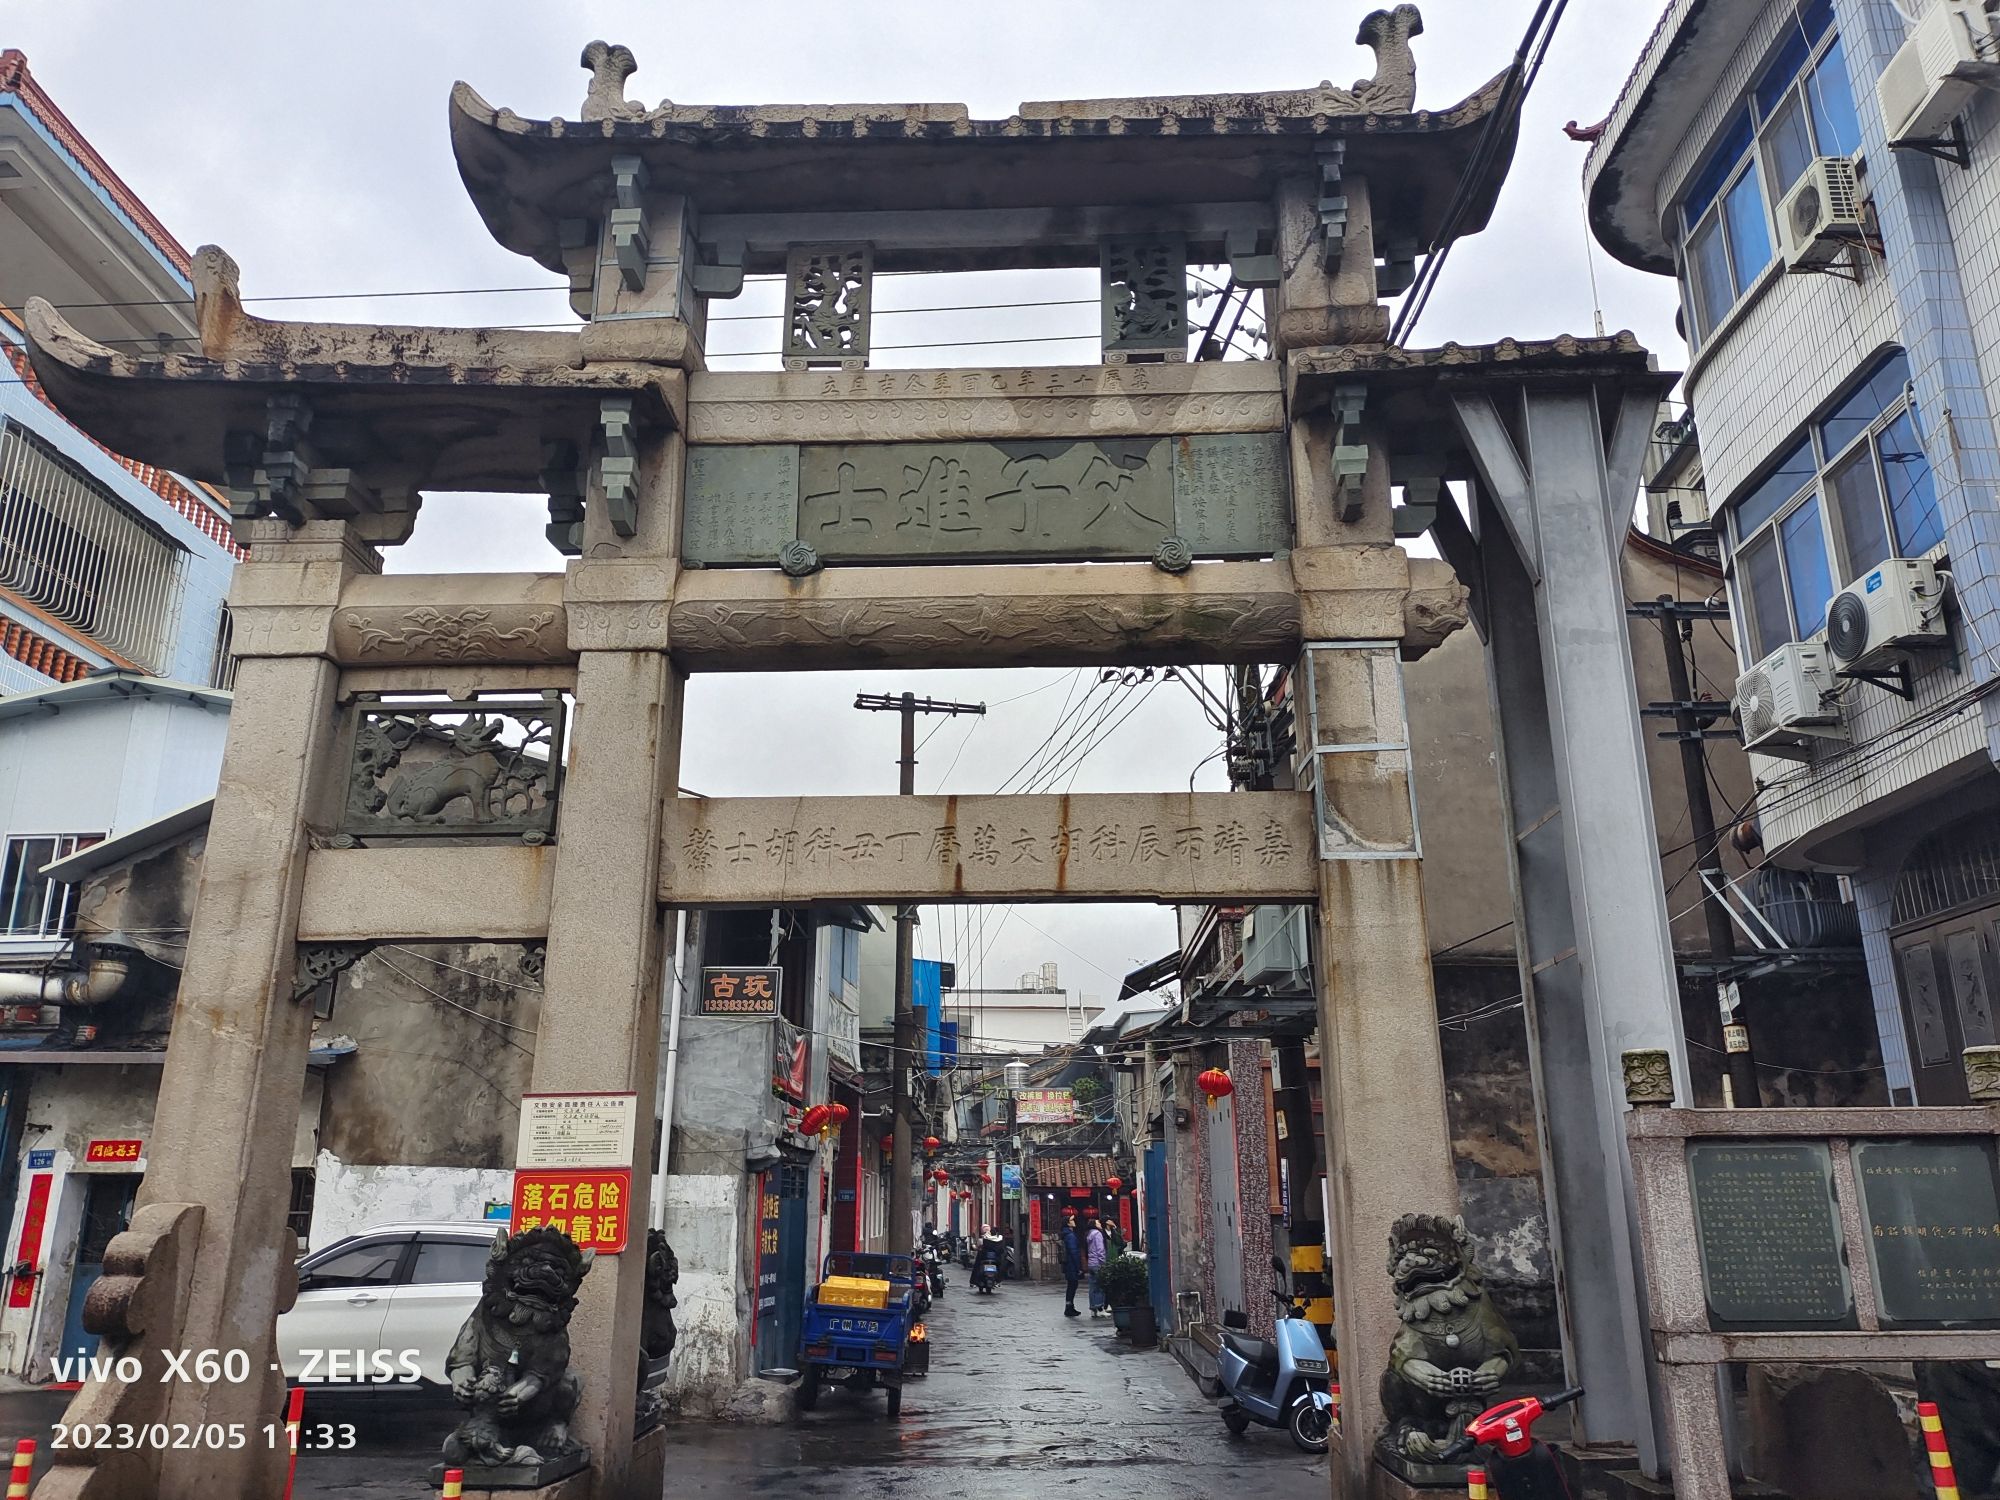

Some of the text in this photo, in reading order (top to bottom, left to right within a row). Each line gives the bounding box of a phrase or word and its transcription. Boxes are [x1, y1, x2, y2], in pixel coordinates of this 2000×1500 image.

[710, 973, 773, 998] 古玩
[522, 1182, 620, 1211] 落石危险
